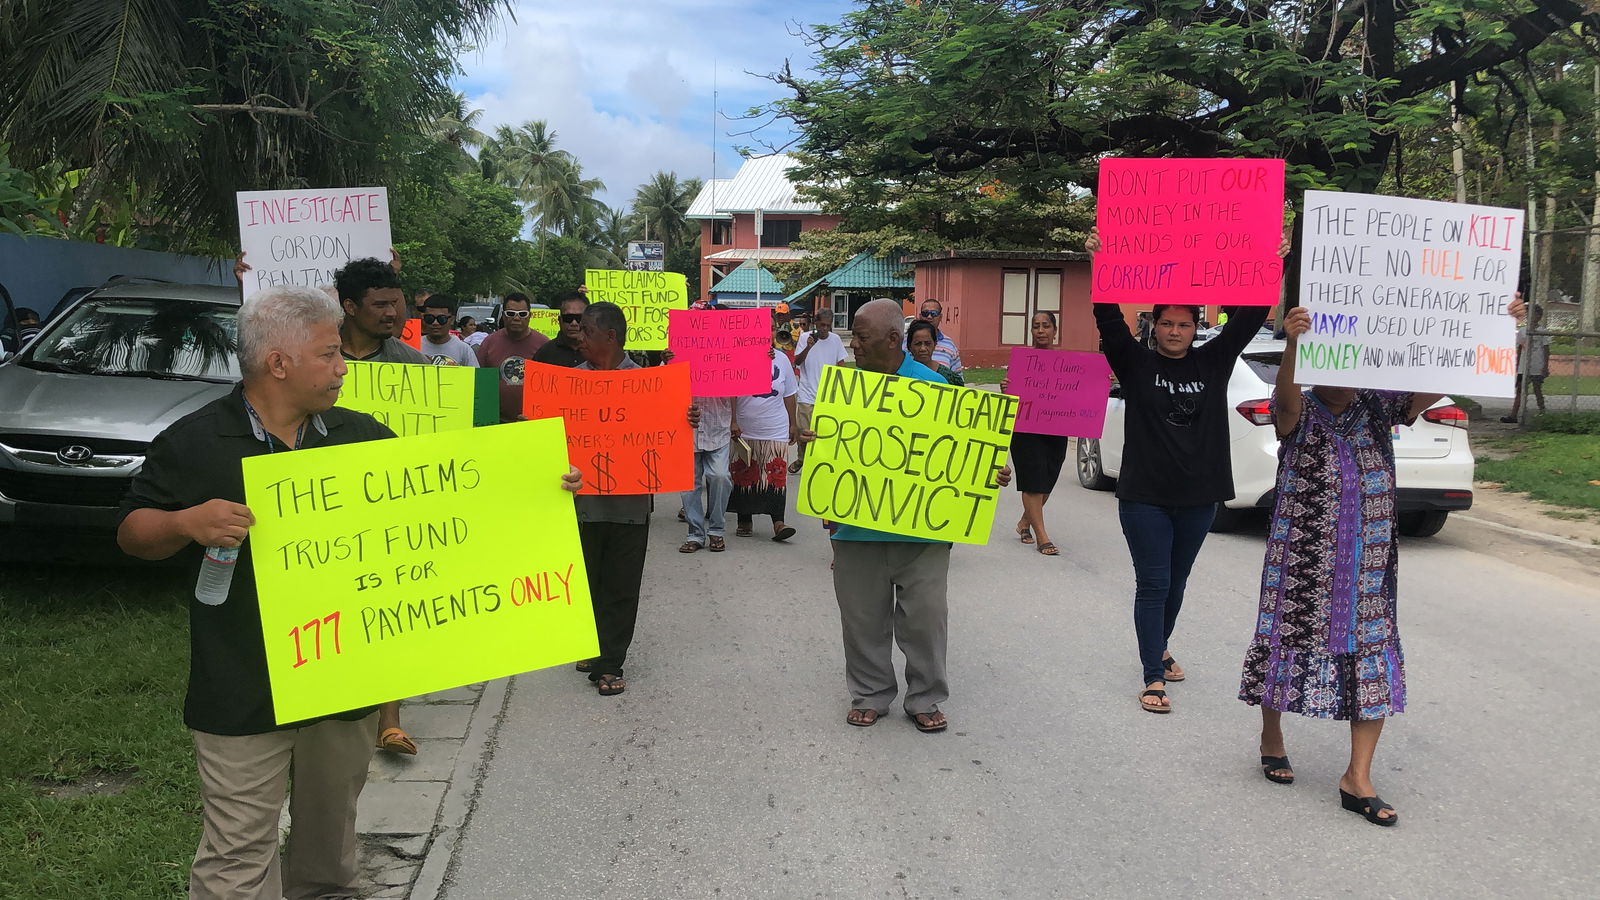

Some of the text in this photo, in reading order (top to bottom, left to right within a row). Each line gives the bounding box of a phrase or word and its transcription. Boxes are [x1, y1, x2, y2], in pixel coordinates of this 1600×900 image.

[1108, 167, 1268, 197] DON'T PUT OUR
[244, 194, 382, 226] INVESTIGATE
[1107, 202, 1243, 226] MONEY IN THE
[1310, 205, 1516, 251] THE PEOPLE ON KILI
[271, 233, 350, 262] GORDON
[1106, 232, 1252, 254] HANDS OF OUR
[1097, 260, 1281, 293] CORRUPT LEADERS
[1311, 244, 1508, 284] HAVE NO FUEL FOR
[587, 271, 666, 290] THE CLAIMS
[588, 290, 679, 304] TRUST FUND
[1307, 282, 1509, 316] THEIR GENERATOR. THE
[622, 306, 669, 323] OT FOR
[690, 315, 763, 330] WE NEED A
[1367, 315, 1407, 337] USED
[1413, 316, 1437, 337] UP
[1441, 317, 1473, 339] THE
[627, 326, 652, 342] ORS
[671, 336, 729, 349] CRIMINAL
[704, 353, 731, 363] OF THE
[1026, 355, 1086, 374] The Claims
[1300, 341, 1363, 370] MONEY
[1363, 347, 1383, 367] AND
[1387, 349, 1405, 367] NOW
[1407, 341, 1434, 367] THEY
[1437, 345, 1463, 369] HAVE
[1463, 349, 1476, 368] NO
[338, 362, 459, 409] TIGATE
[530, 371, 663, 396] OUR TRUST FUND
[723, 368, 749, 381] FUND
[1024, 377, 1080, 391] Trust Fund
[532, 405, 544, 417] IS
[559, 408, 589, 421] THE
[820, 367, 1019, 435] INVESTIGATE
[567, 430, 676, 448] AYER'S MONEY
[810, 414, 1008, 489] PROSECUTE
[266, 459, 481, 518] THE CLAIMS
[807, 462, 992, 537] CONVICT
[276, 517, 468, 571] TRUST FUND
[354, 561, 438, 591] IS FOR
[288, 563, 573, 669] 177 PAYMENTS ONLY
